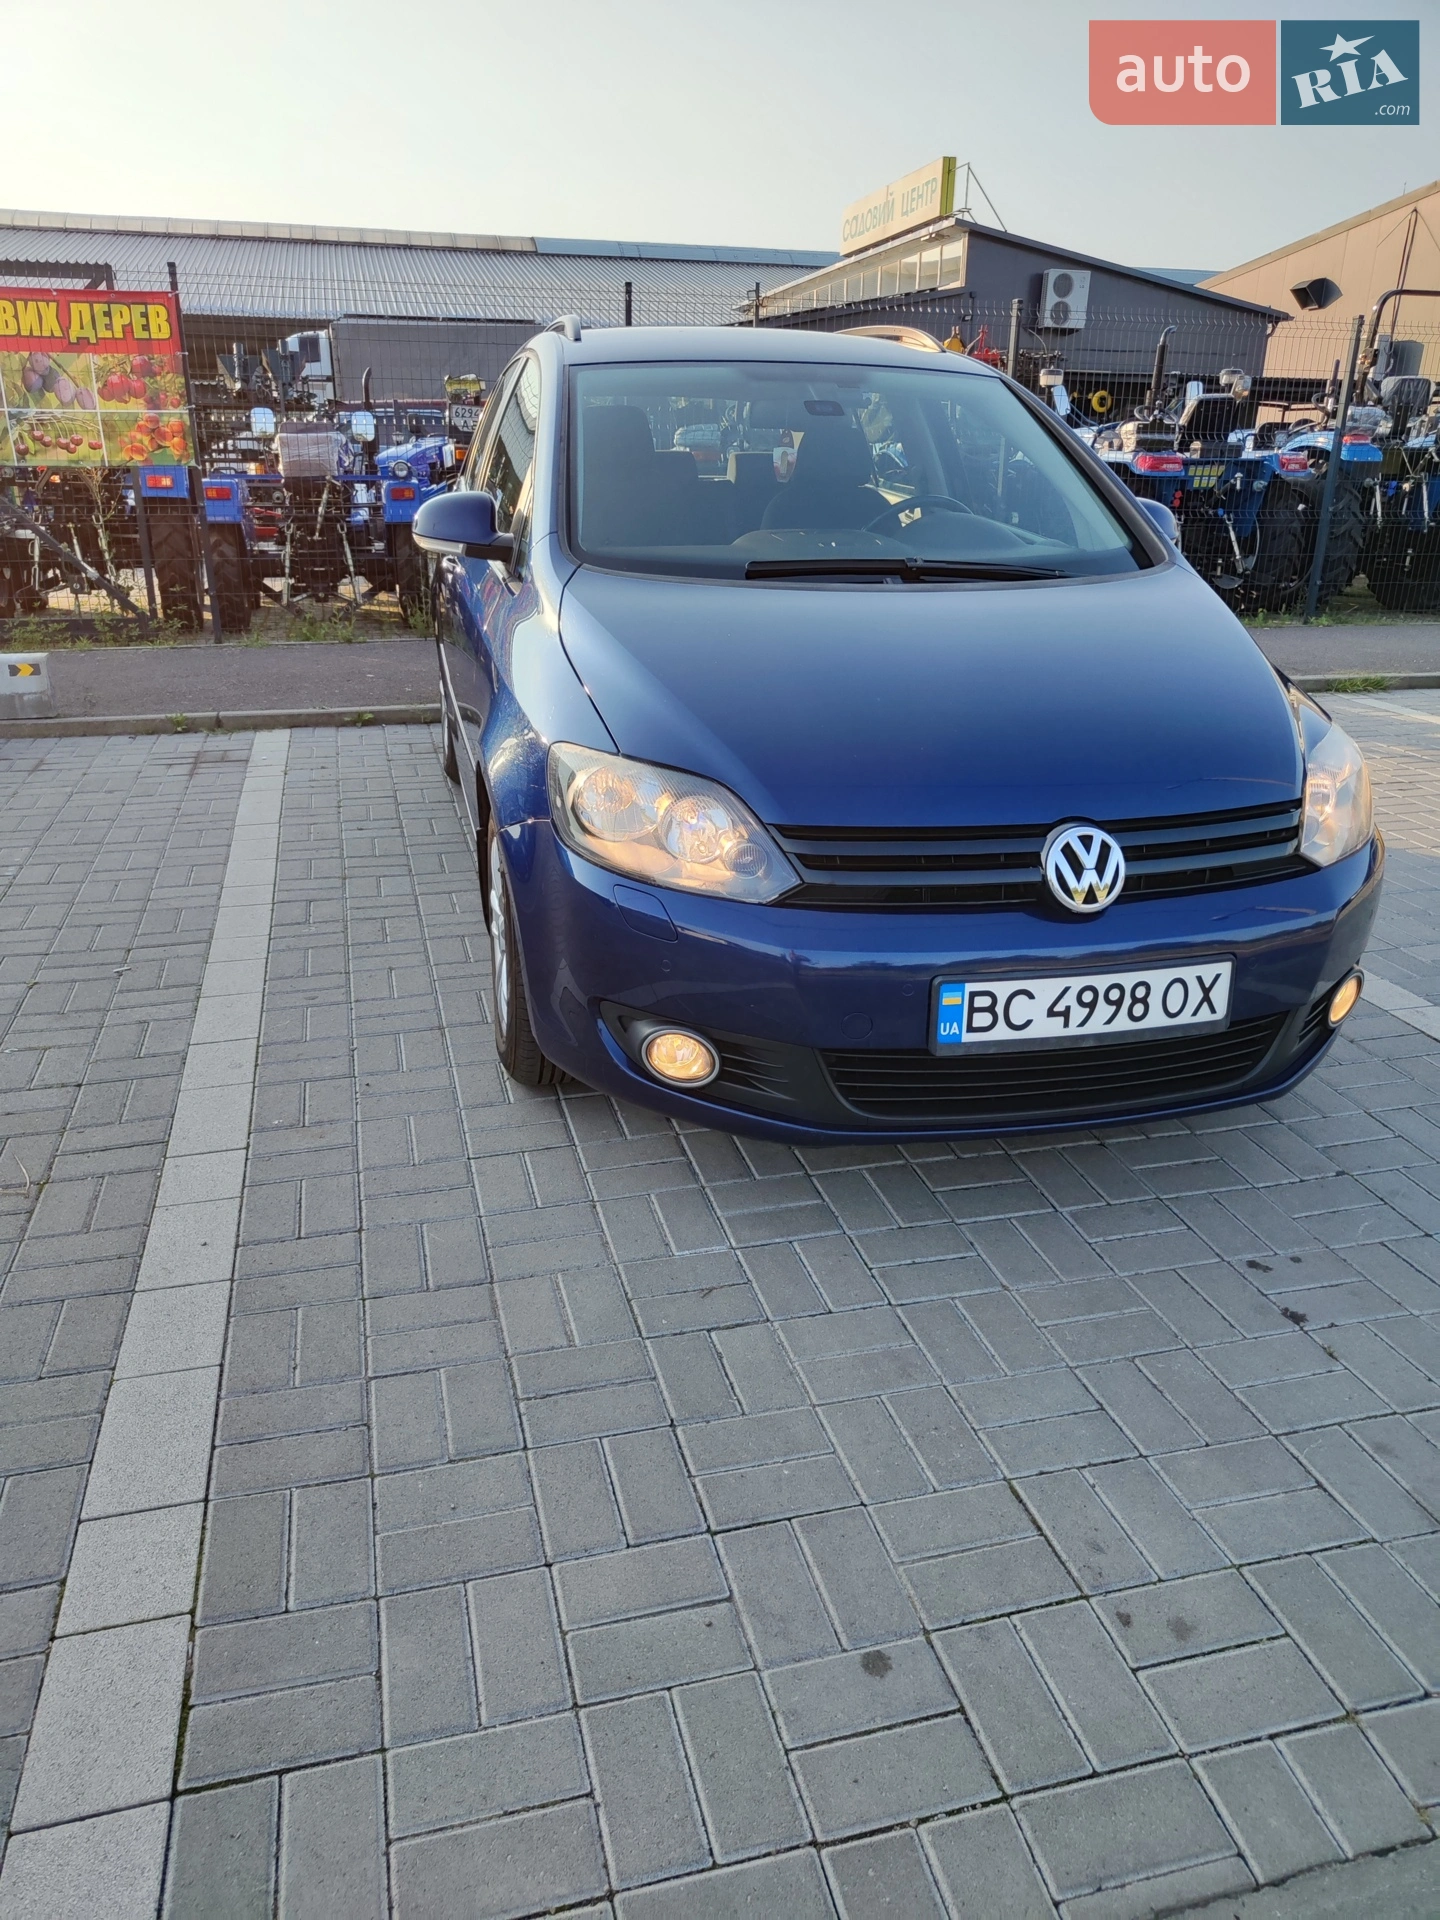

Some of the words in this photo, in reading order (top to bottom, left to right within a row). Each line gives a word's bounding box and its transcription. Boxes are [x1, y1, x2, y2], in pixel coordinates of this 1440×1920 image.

[901, 177, 938, 218] ЦЕНТР
[68, 301, 172, 344] ДЕРЕВ
[454, 406, 482, 418] 6294
[966, 988, 1036, 1033] BC
[1046, 980, 1152, 1029] 4998
[1161, 972, 1223, 1019] OX
[940, 1021, 960, 1036] UA
